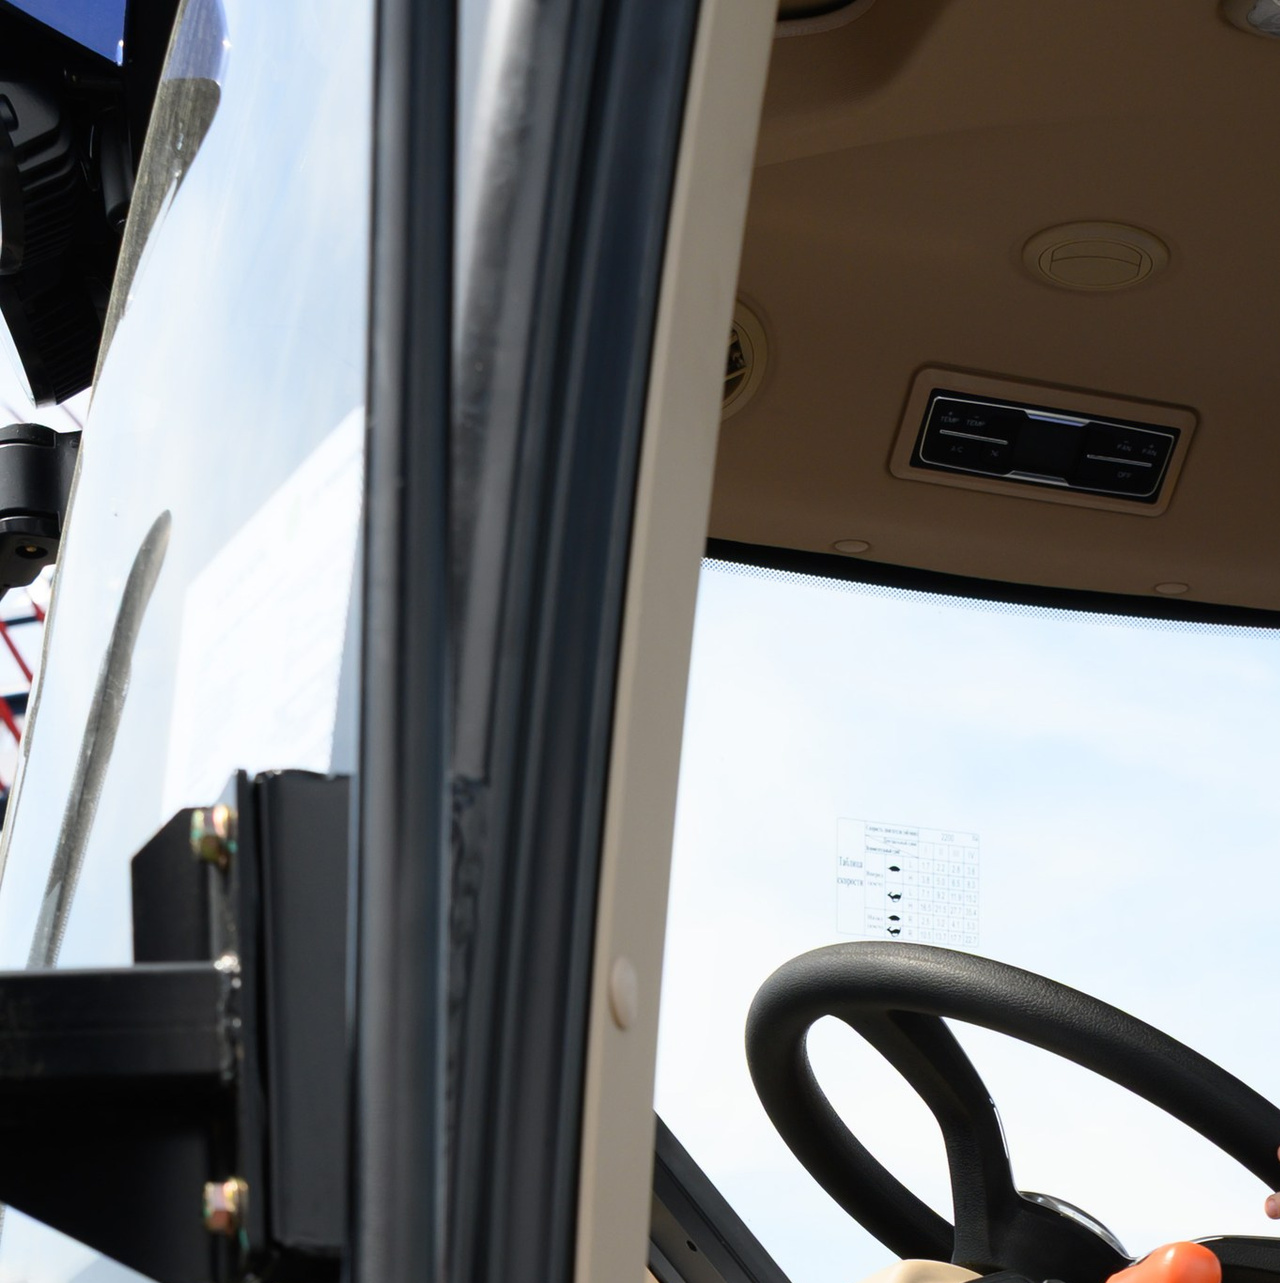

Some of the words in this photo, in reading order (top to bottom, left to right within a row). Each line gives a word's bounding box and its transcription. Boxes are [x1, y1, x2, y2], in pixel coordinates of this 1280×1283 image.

[940, 415, 959, 424] TEMP
[966, 418, 986, 427] TEMP
[1116, 444, 1132, 452] FAN
[1142, 448, 1157, 456] FAN
